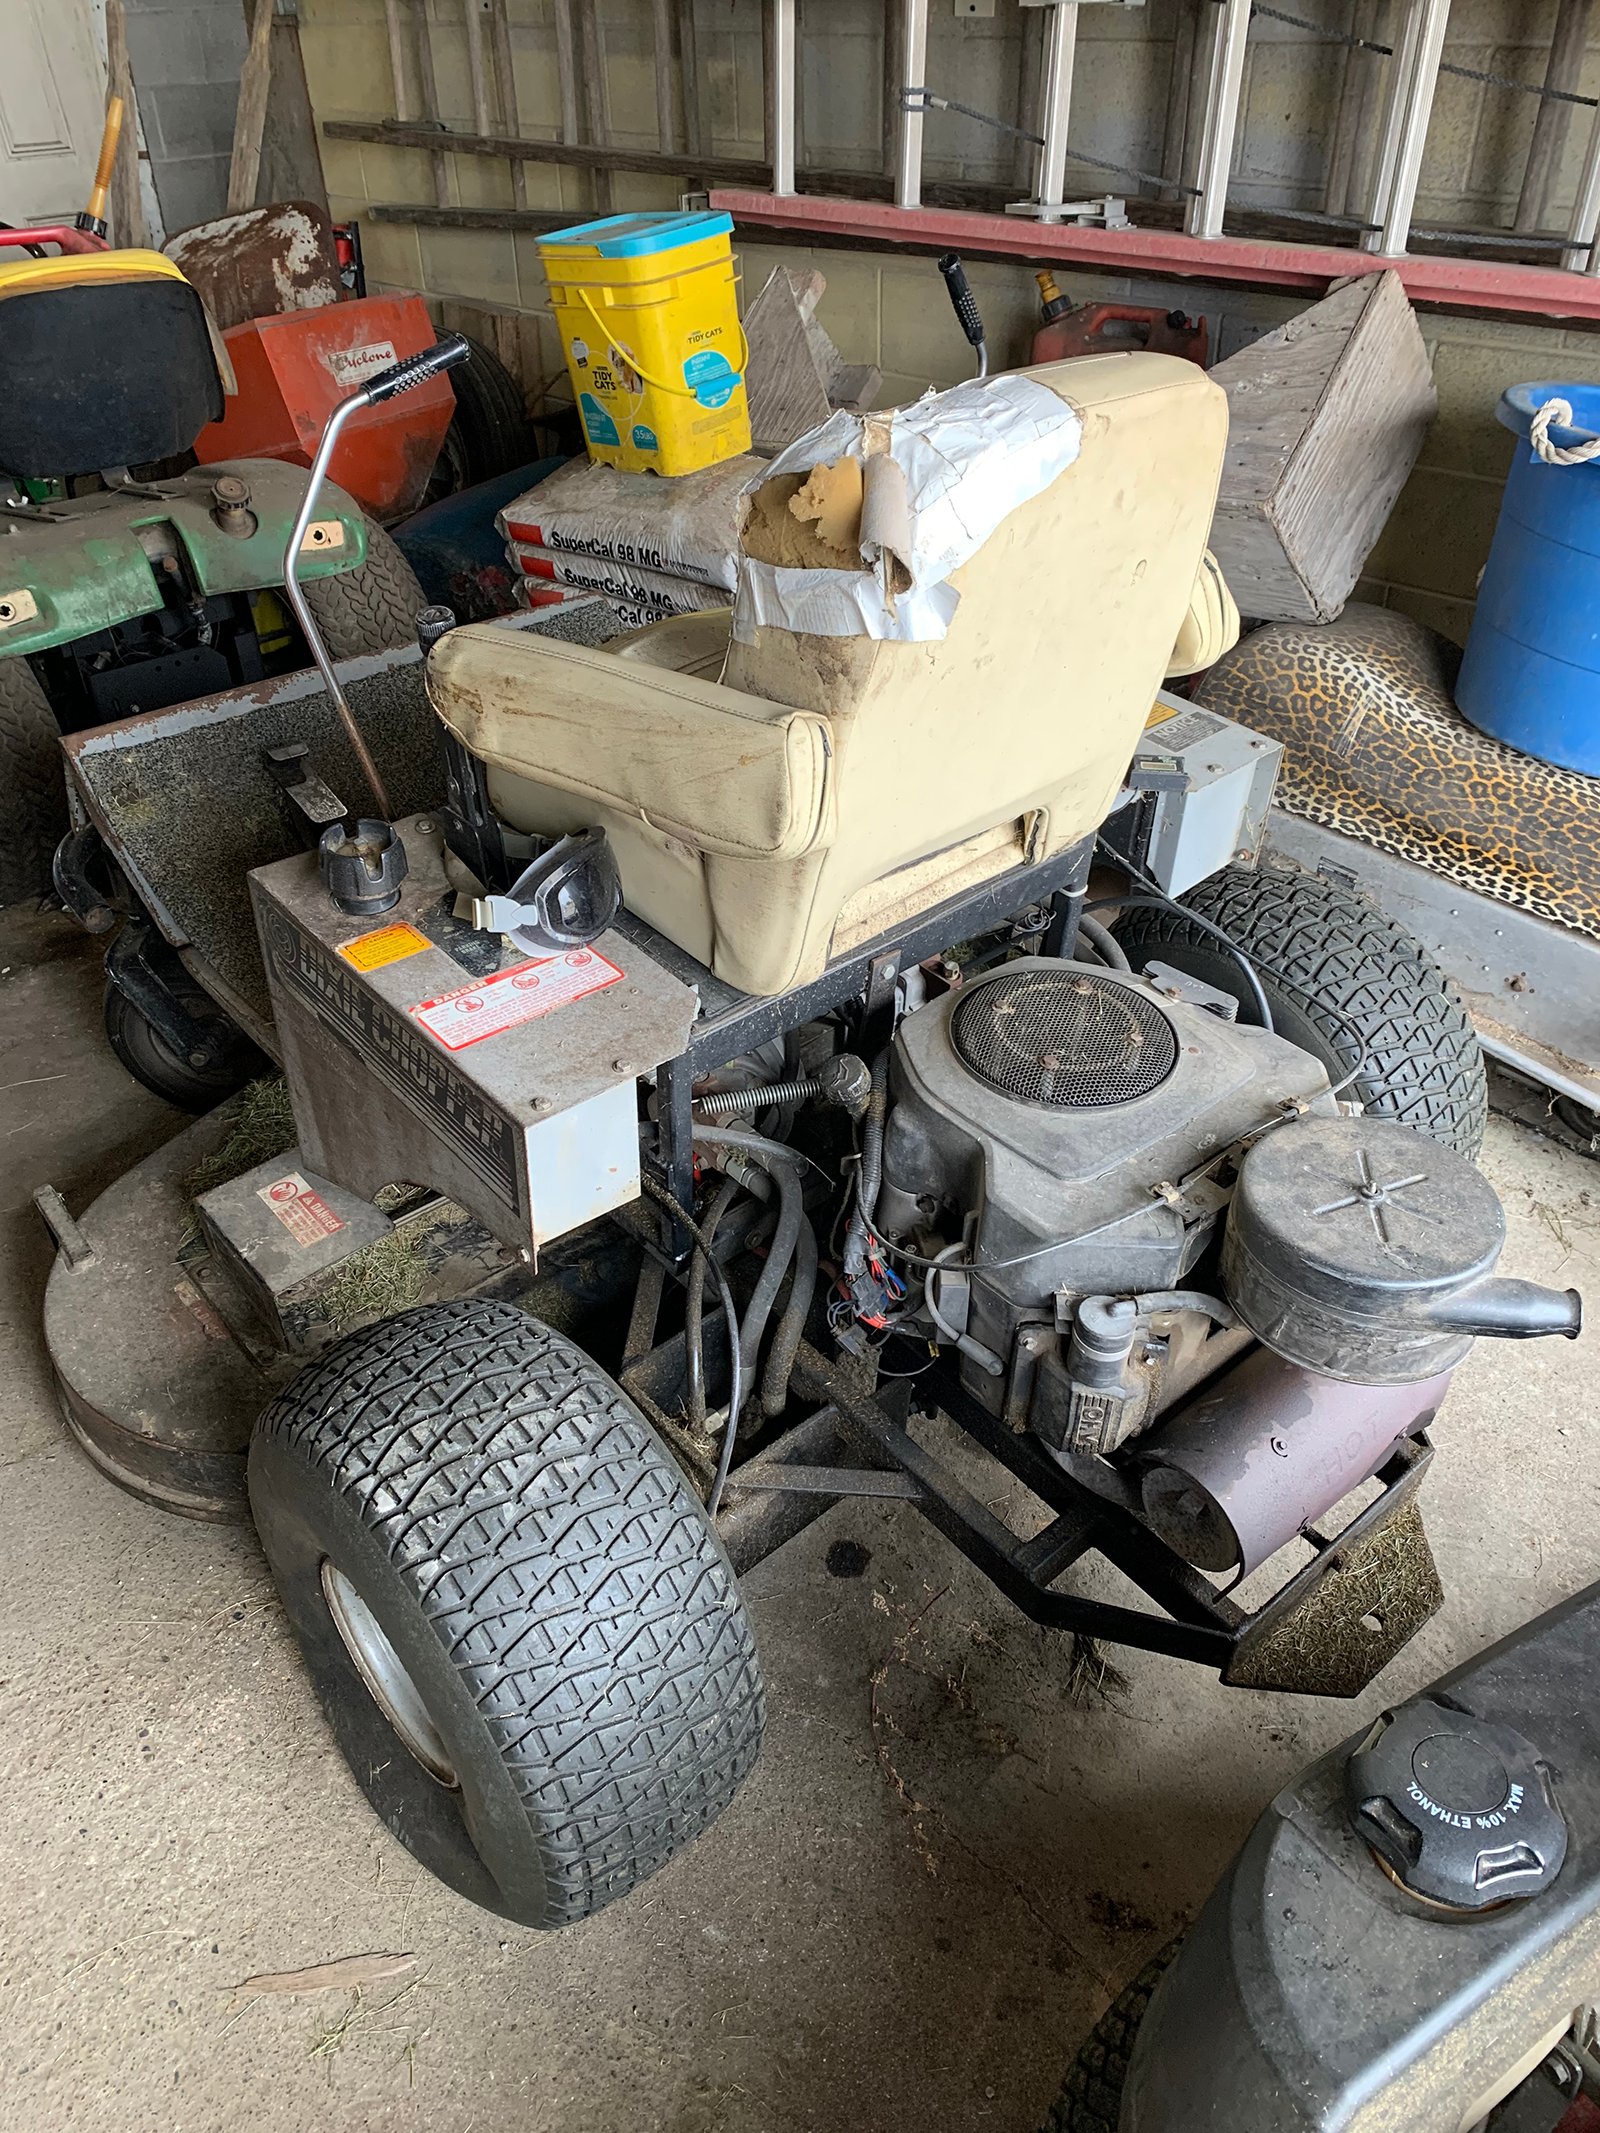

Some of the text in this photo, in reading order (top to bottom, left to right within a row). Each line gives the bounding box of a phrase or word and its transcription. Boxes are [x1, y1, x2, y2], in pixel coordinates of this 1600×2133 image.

[688, 327, 722, 345] TIDY CATS
[593, 370, 612, 381] TIDY
[594, 381, 616, 391] CATS
[551, 531, 614, 559] SuperCal
[617, 544, 635, 563] 98
[638, 547, 662, 568] MG
[563, 568, 627, 598] SuperCal
[630, 584, 648, 604] 98
[650, 591, 674, 611] MG
[613, 605, 643, 625] Cal
[1153, 715, 1200, 739] NOTICE
[433, 980, 488, 1004] DANGER
[310, 1203, 339, 1231] DANGER
[1406, 1781, 1524, 1830] MAX. 10% ETHANOL
